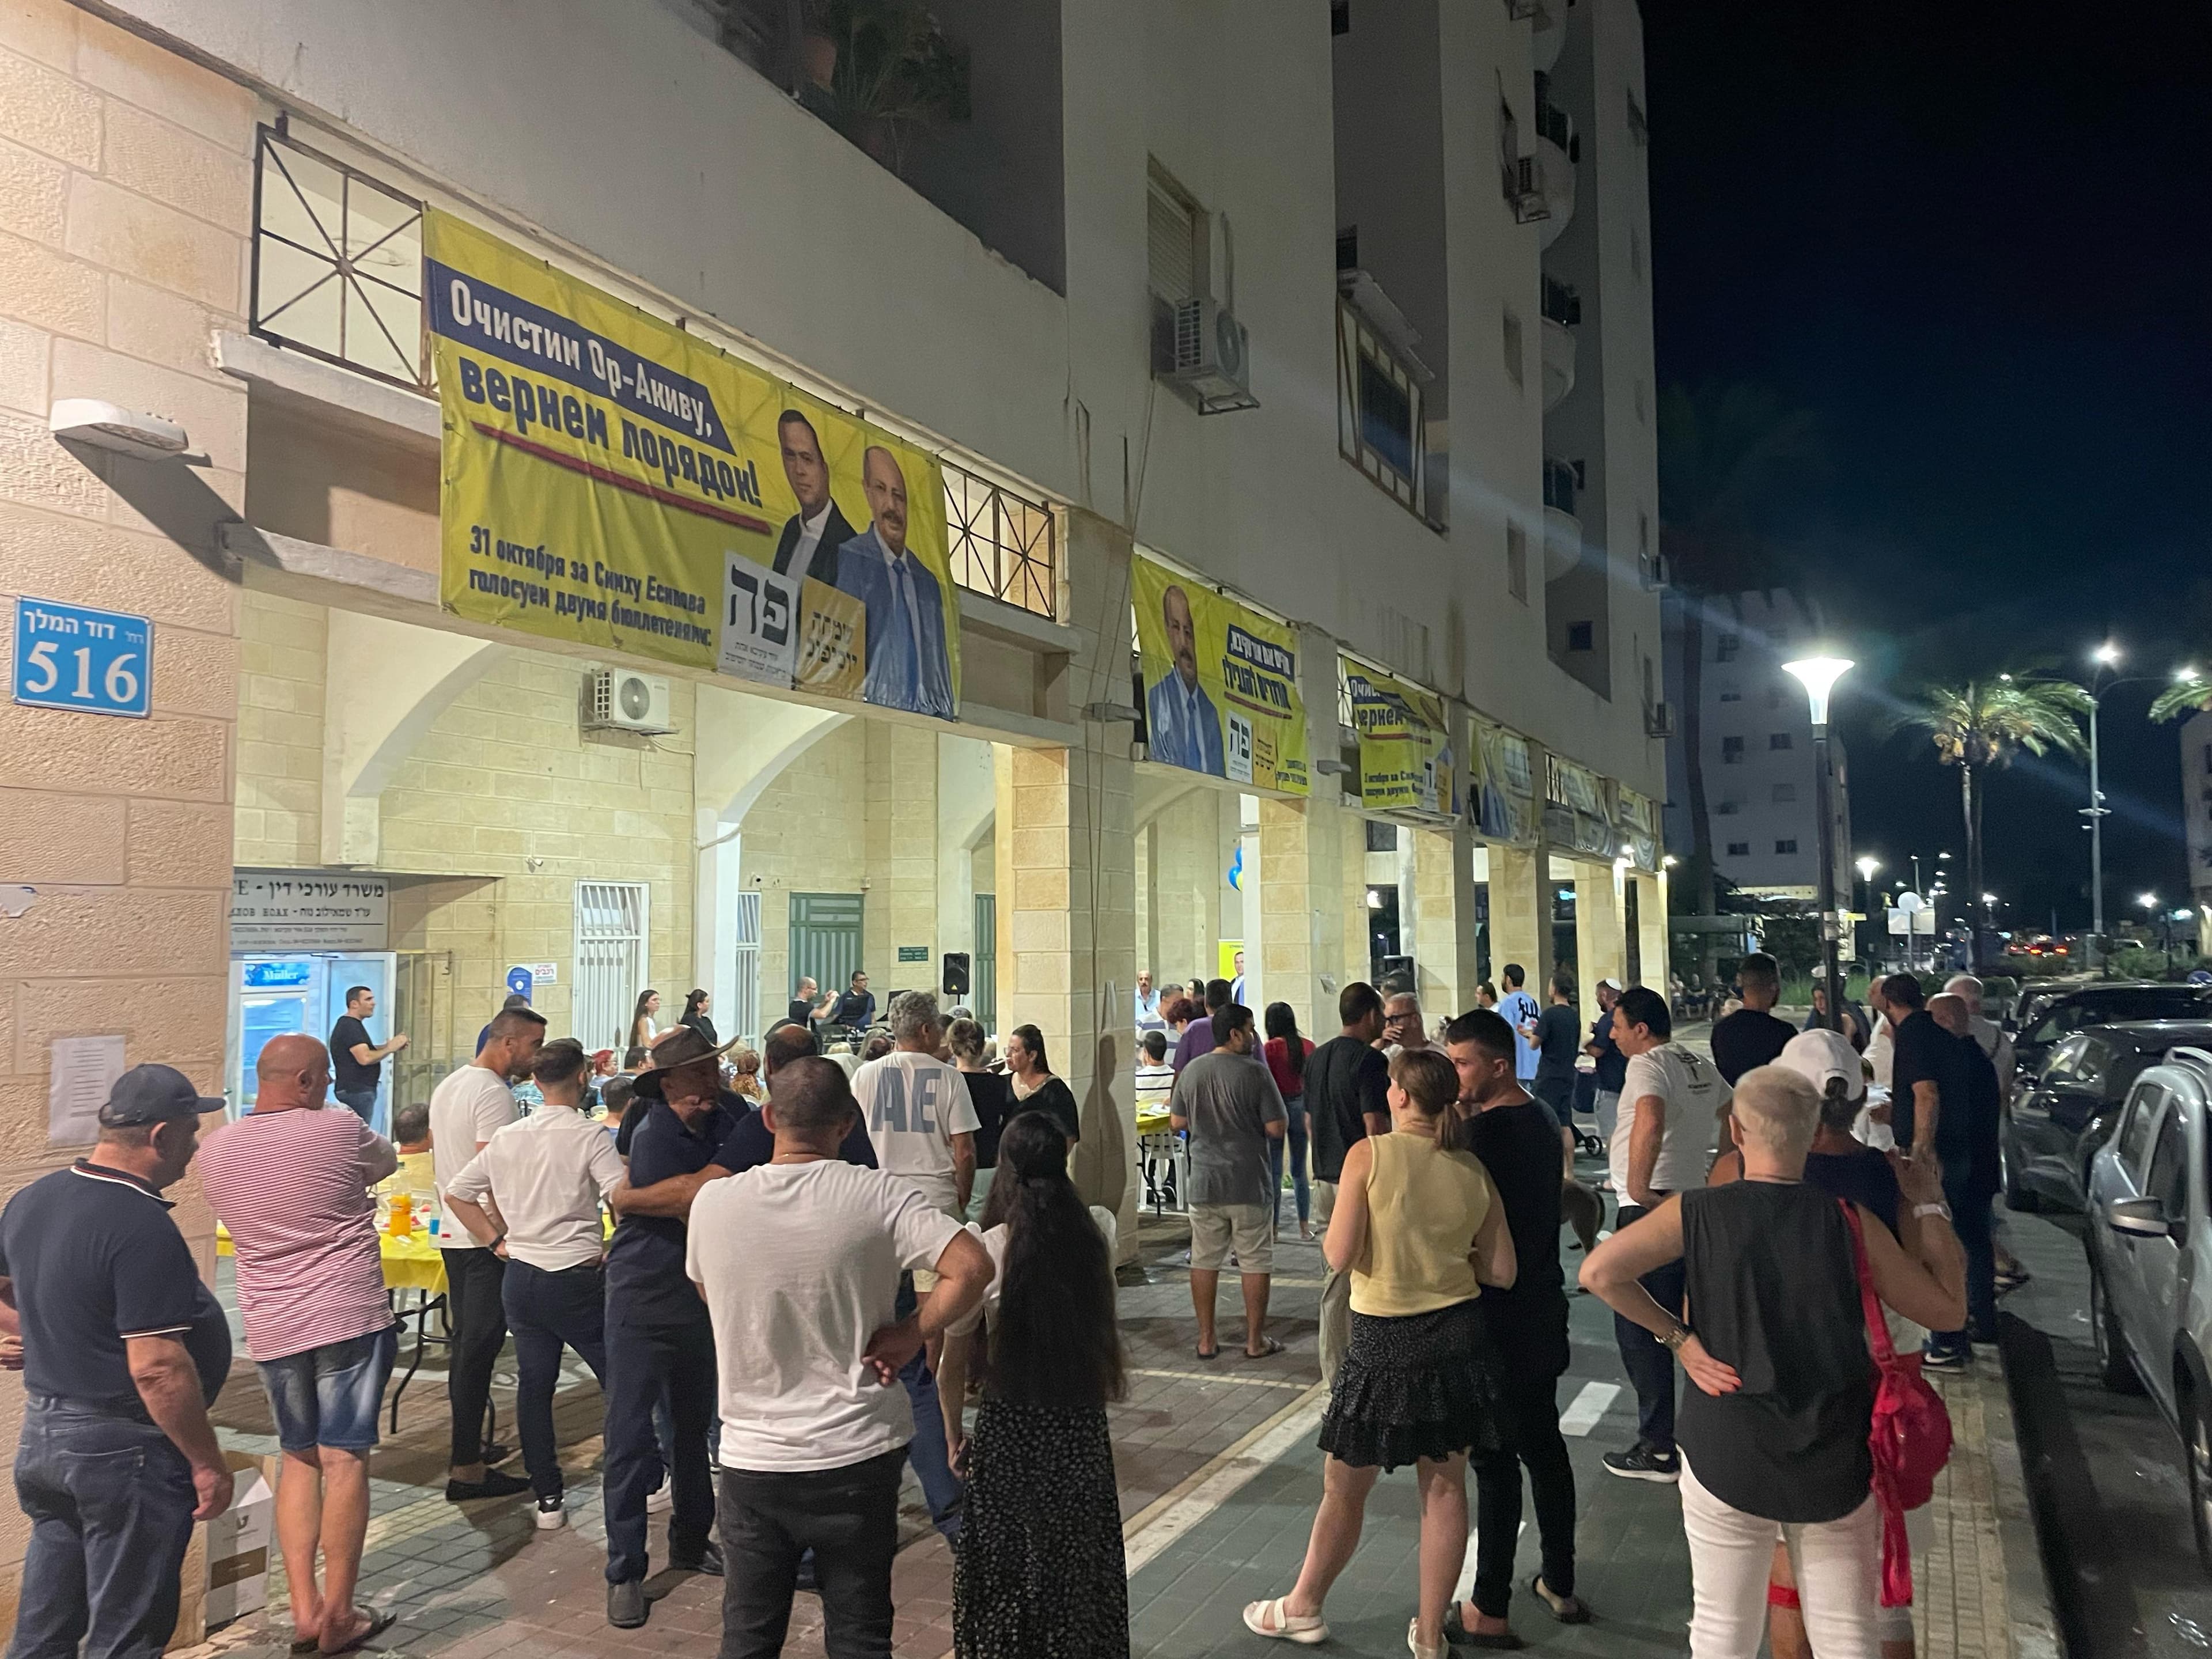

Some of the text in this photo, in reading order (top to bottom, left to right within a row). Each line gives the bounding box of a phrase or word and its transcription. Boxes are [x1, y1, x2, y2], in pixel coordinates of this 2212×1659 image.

[450, 279, 713, 438] Очистим Ор-Акиву,
[459, 357, 763, 508] вернем порядок!
[470, 525, 490, 556] 31
[497, 545, 565, 580] октября
[571, 561, 588, 584] за
[24, 608, 79, 634] המלך
[469, 569, 550, 608] голосуем
[555, 590, 607, 623] двумя
[730, 564, 789, 646] פה
[84, 621, 116, 639] דוד
[25, 641, 138, 703] 516
[268, 881, 291, 900] דין
[298, 882, 338, 898] עורכי
[343, 884, 384, 897] משרד
[870, 1067, 941, 1134] AE
